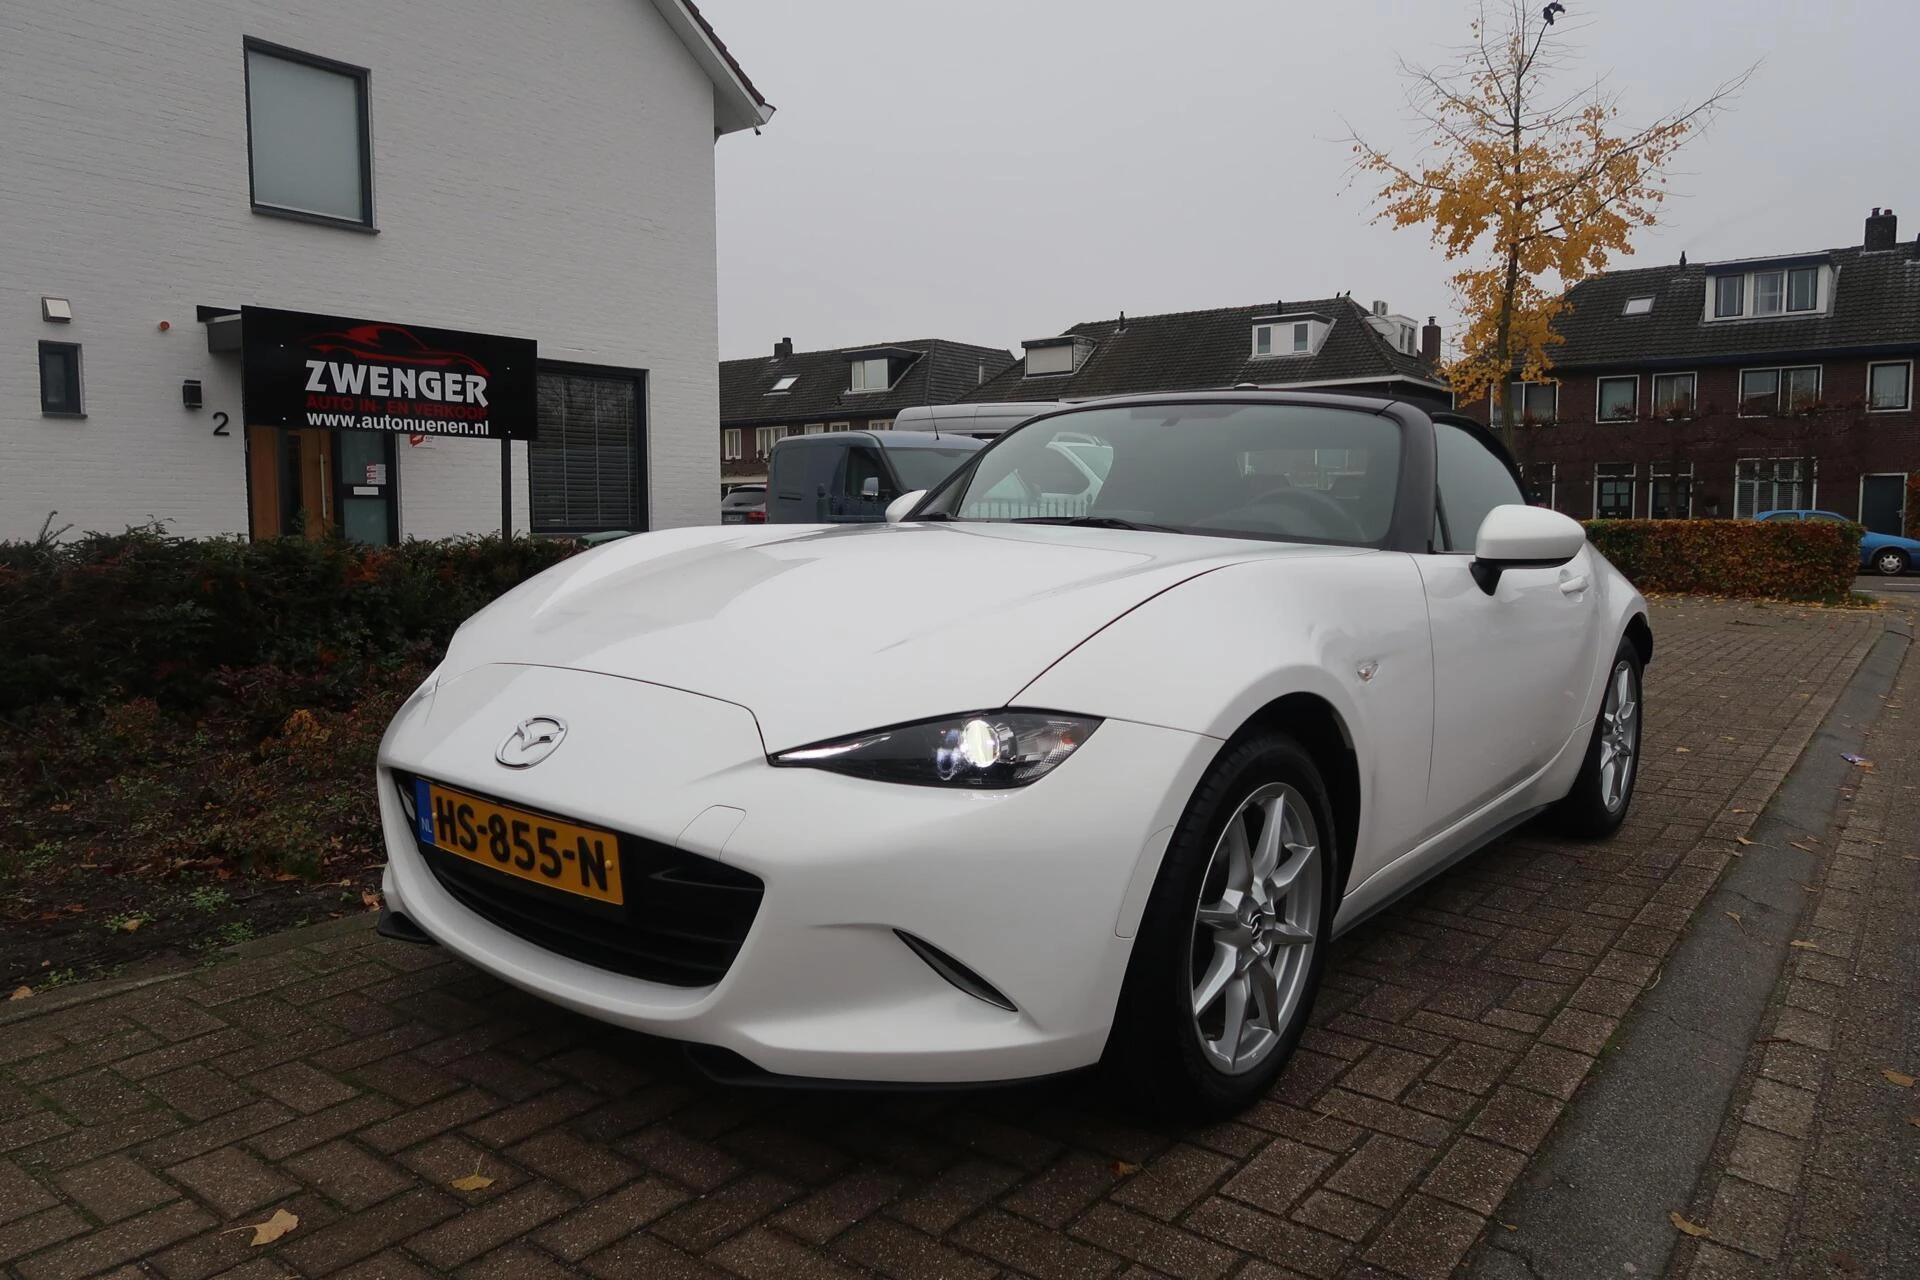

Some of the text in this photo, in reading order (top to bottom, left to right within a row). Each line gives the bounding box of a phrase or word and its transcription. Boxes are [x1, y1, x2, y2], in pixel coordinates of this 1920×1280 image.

[305, 360, 489, 408] ZWENGER
[306, 394, 488, 420] AUTO IN- EN VERKOOP
[213, 411, 230, 436] 2
[306, 412, 489, 435] www.autonuenen.nl
[421, 817, 433, 833] NL
[436, 796, 608, 892] HS-855-N
